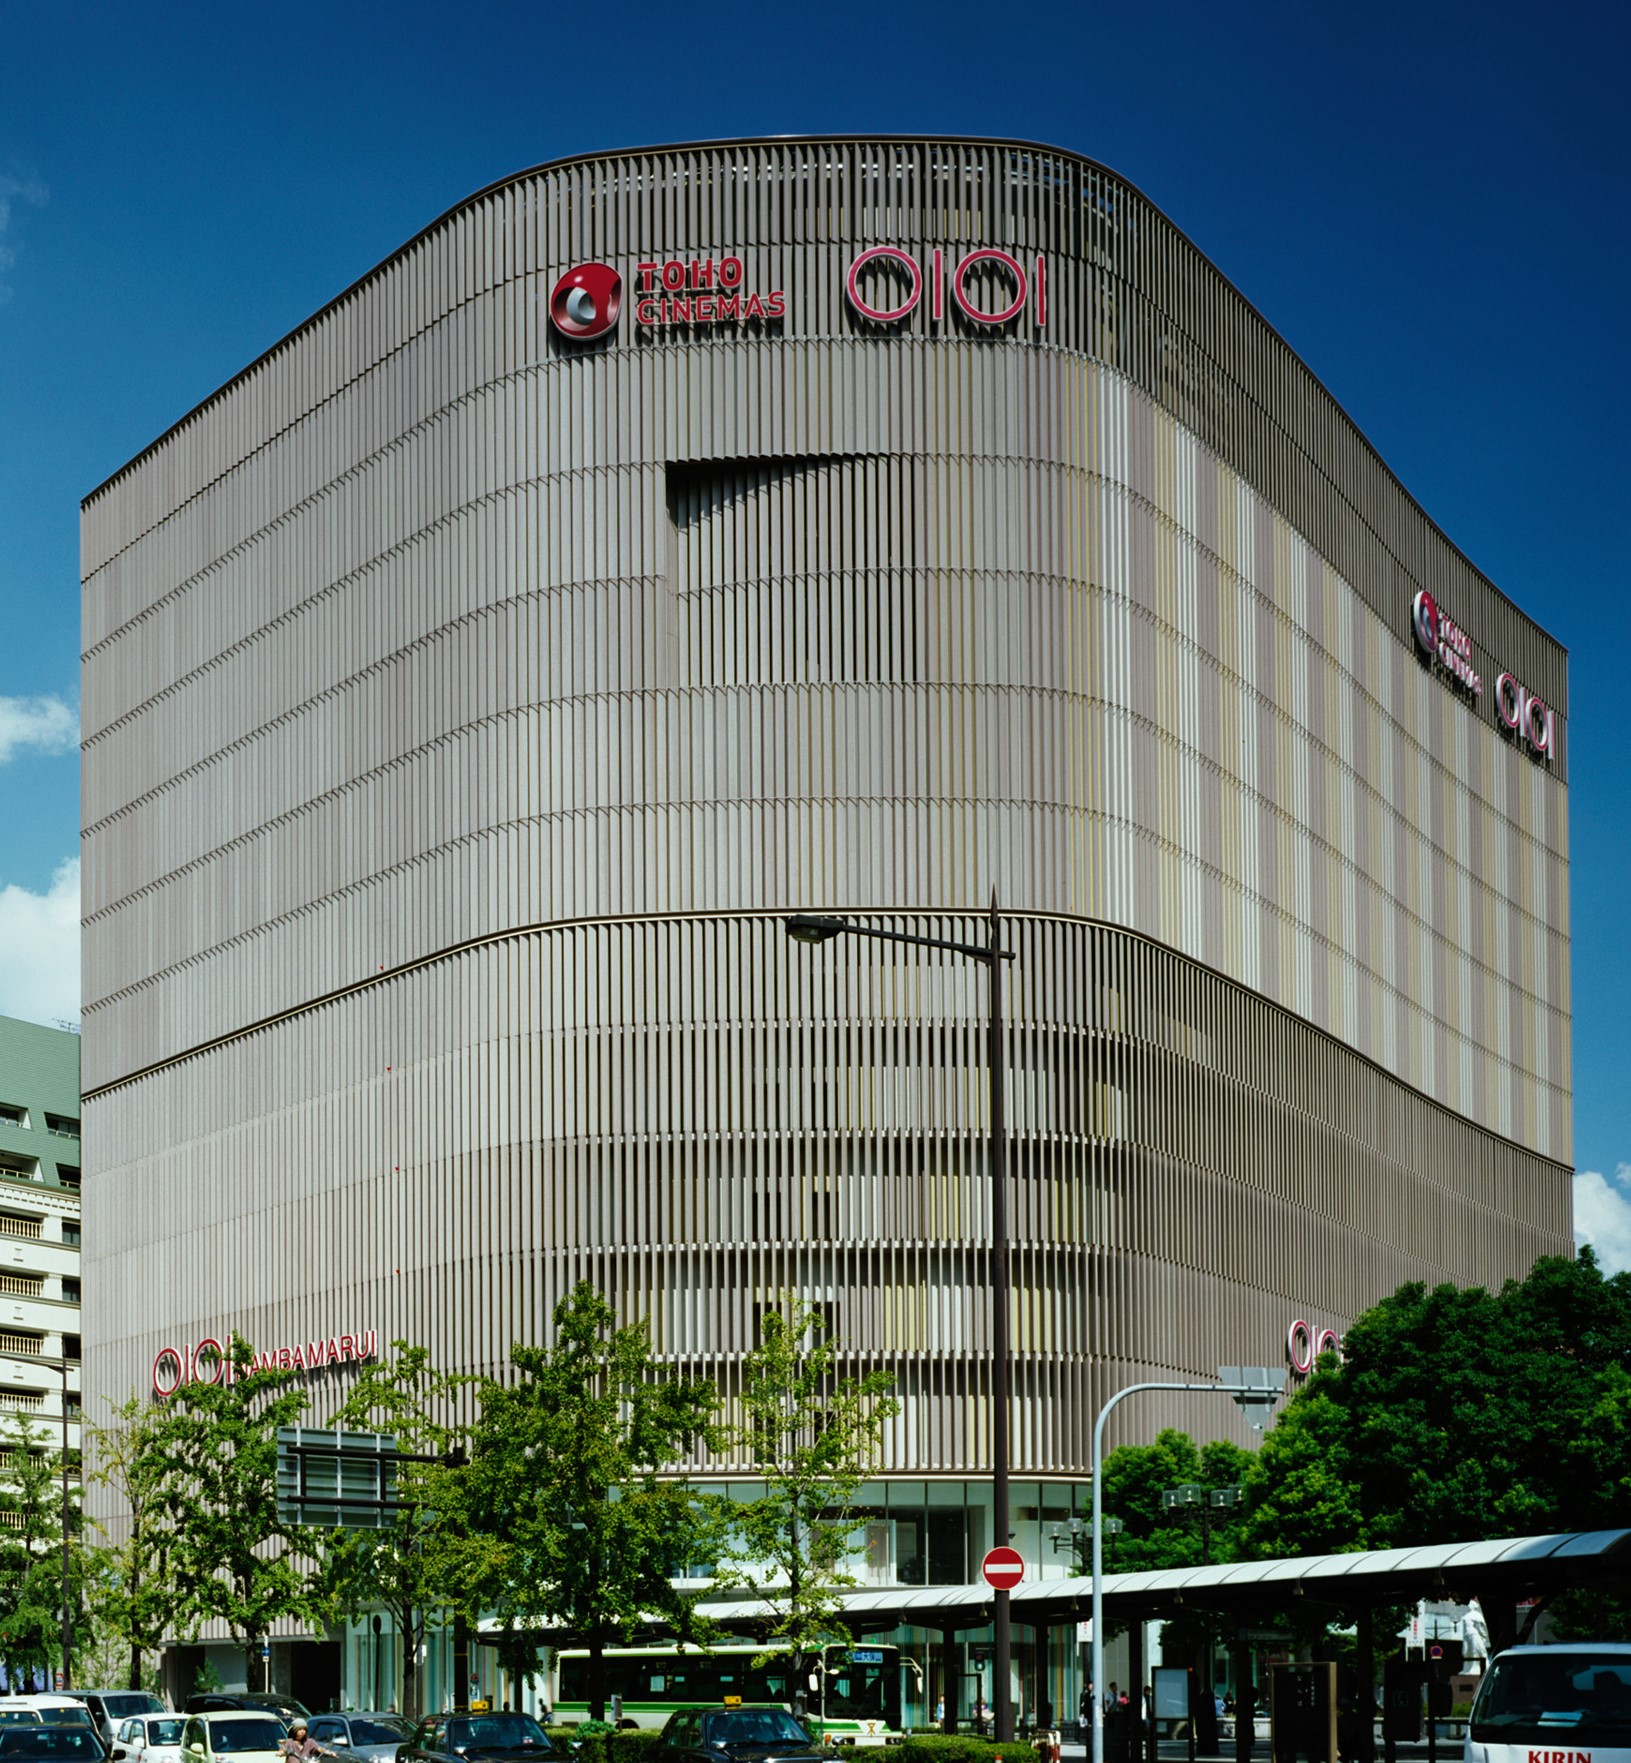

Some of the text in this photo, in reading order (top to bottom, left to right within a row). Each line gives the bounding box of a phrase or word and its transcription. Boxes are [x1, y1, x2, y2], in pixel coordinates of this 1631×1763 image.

[636, 256, 743, 294] TOHO
[636, 290, 787, 326] CINEMAS
[1439, 612, 1472, 661] TOHO
[308, 1328, 378, 1370] MARUI
[1527, 1750, 1592, 1763] KIRIN
